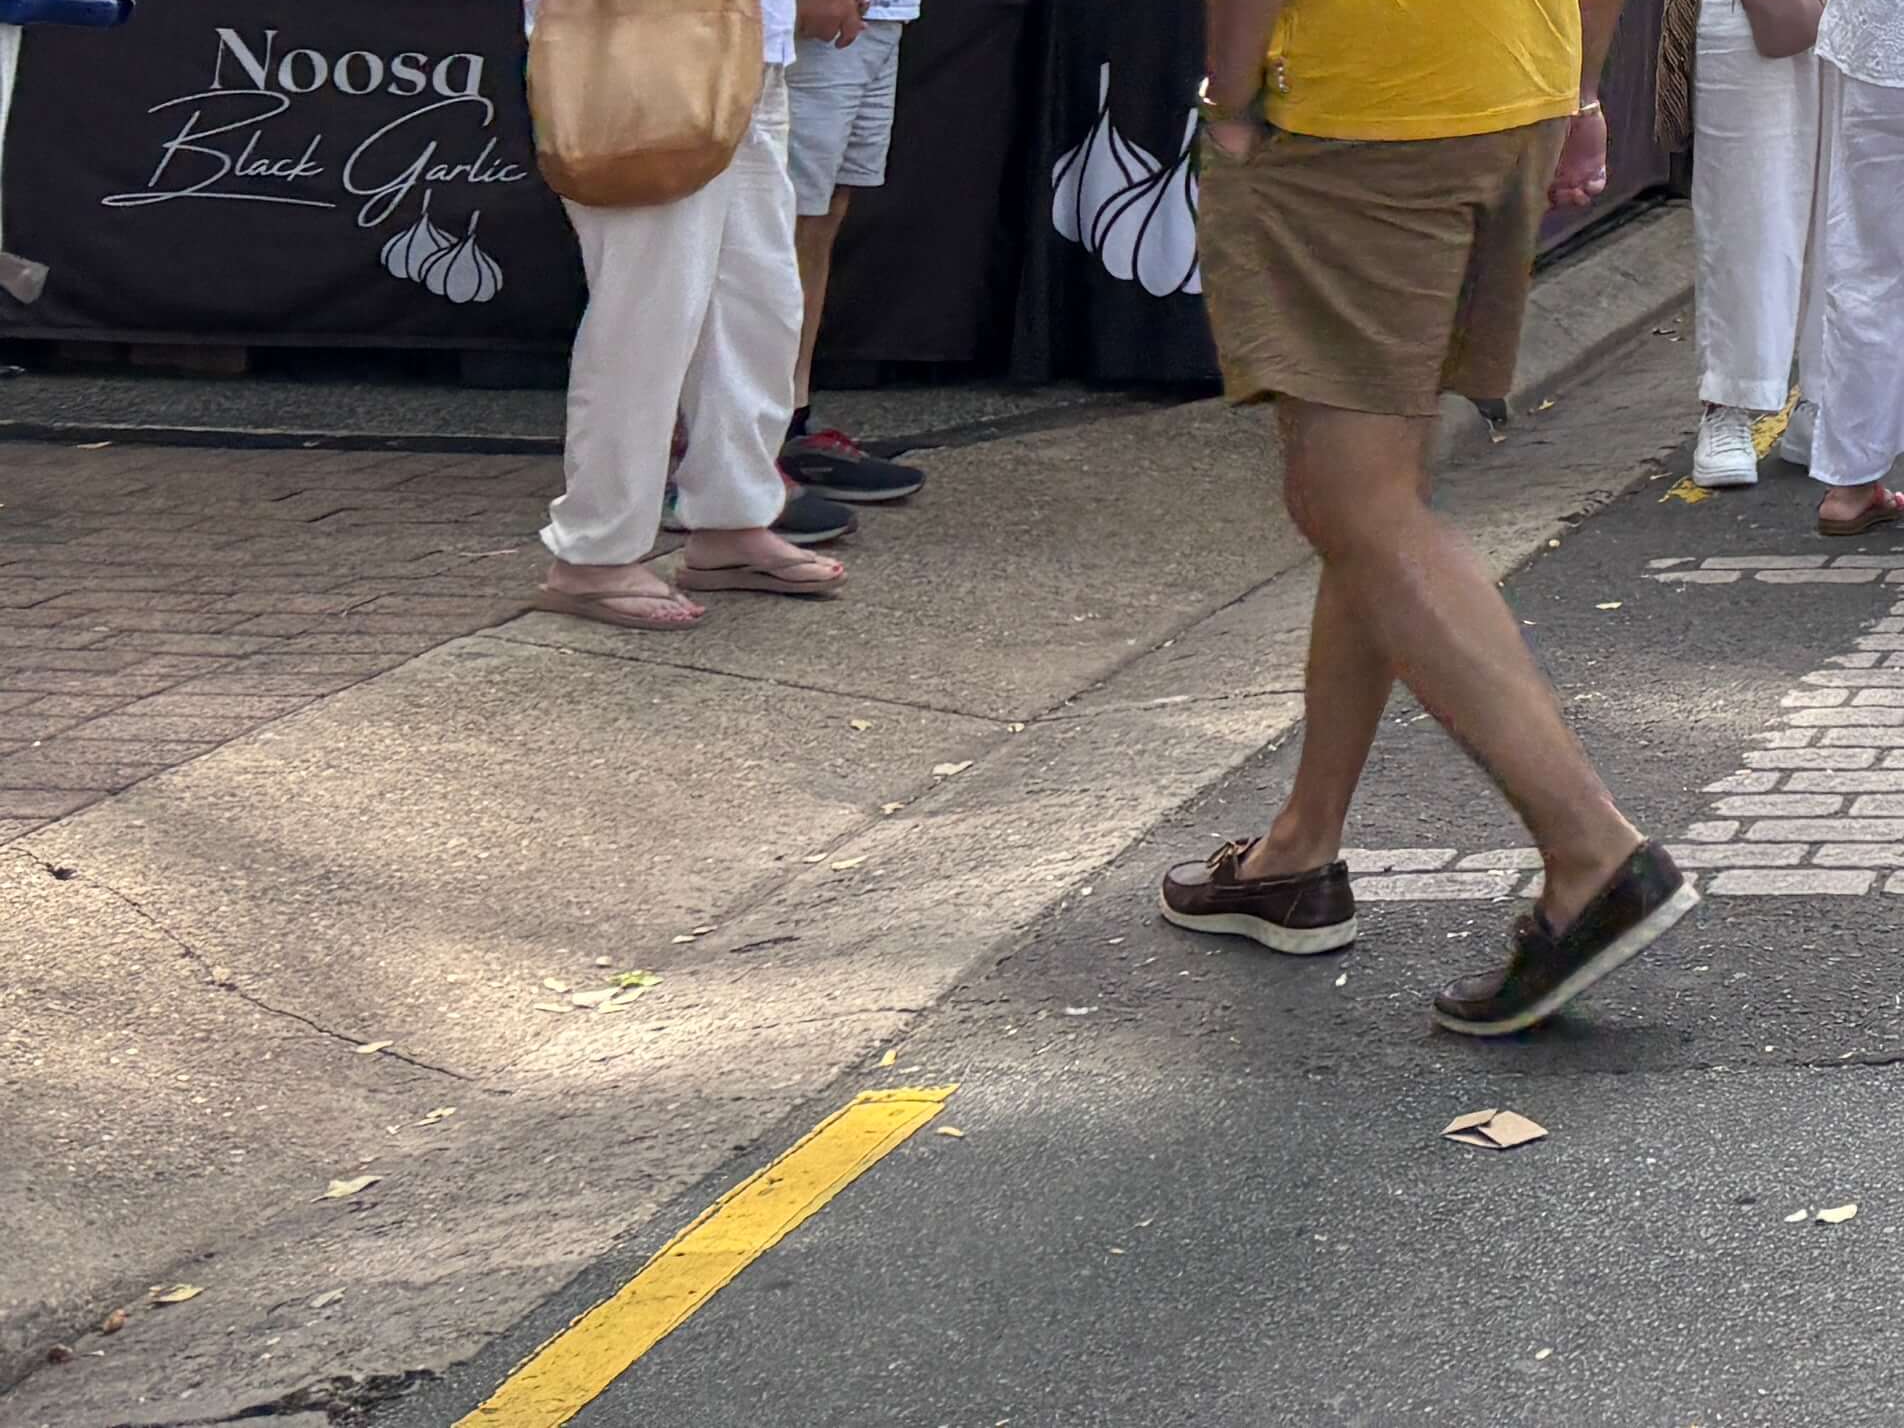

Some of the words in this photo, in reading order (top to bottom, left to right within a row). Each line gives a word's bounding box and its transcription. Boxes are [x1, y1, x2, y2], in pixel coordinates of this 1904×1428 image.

[209, 27, 487, 97] Noosa
[101, 89, 336, 208] Black
[343, 94, 528, 228] Garlic
